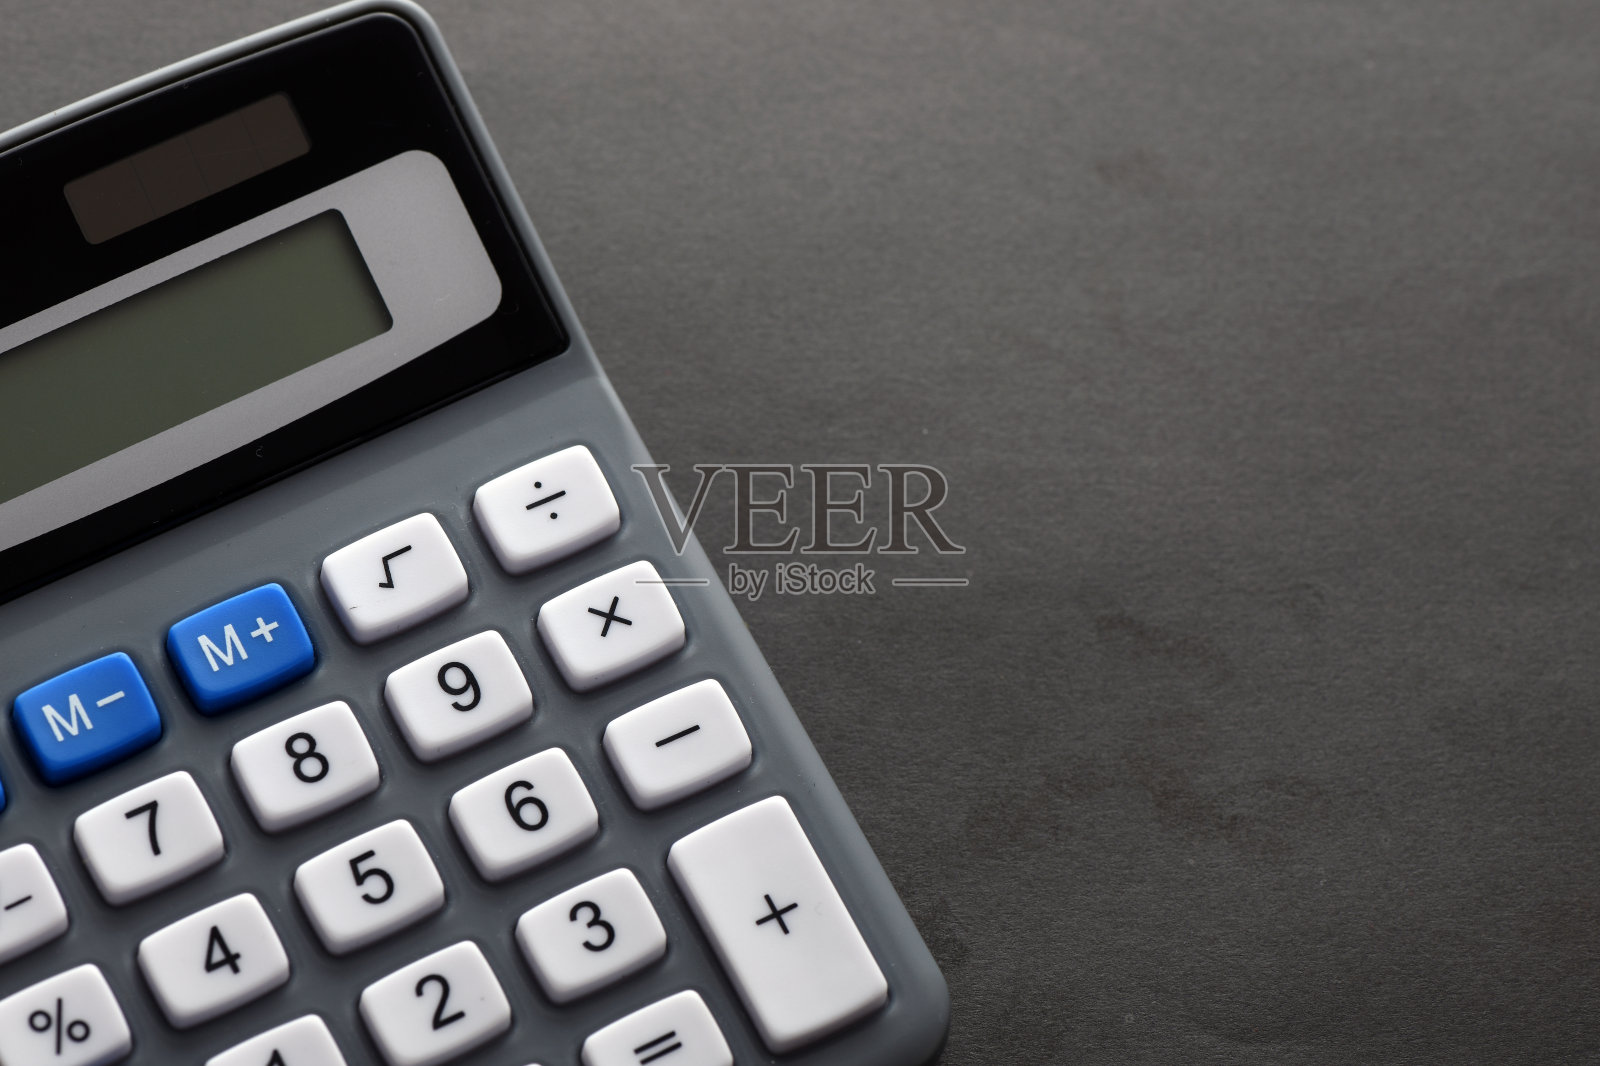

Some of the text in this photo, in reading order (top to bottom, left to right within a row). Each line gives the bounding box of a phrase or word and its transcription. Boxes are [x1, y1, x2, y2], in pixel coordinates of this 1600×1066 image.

[198, 617, 279, 672] M+
[437, 662, 481, 712] 9
[285, 732, 329, 783] 8
[125, 800, 161, 856] 7
[504, 780, 549, 831] 6
[349, 850, 394, 905] 5
[204, 925, 241, 975] 4
[569, 901, 615, 952] 3
[28, 998, 91, 1055] %
[415, 974, 466, 1031] 2
